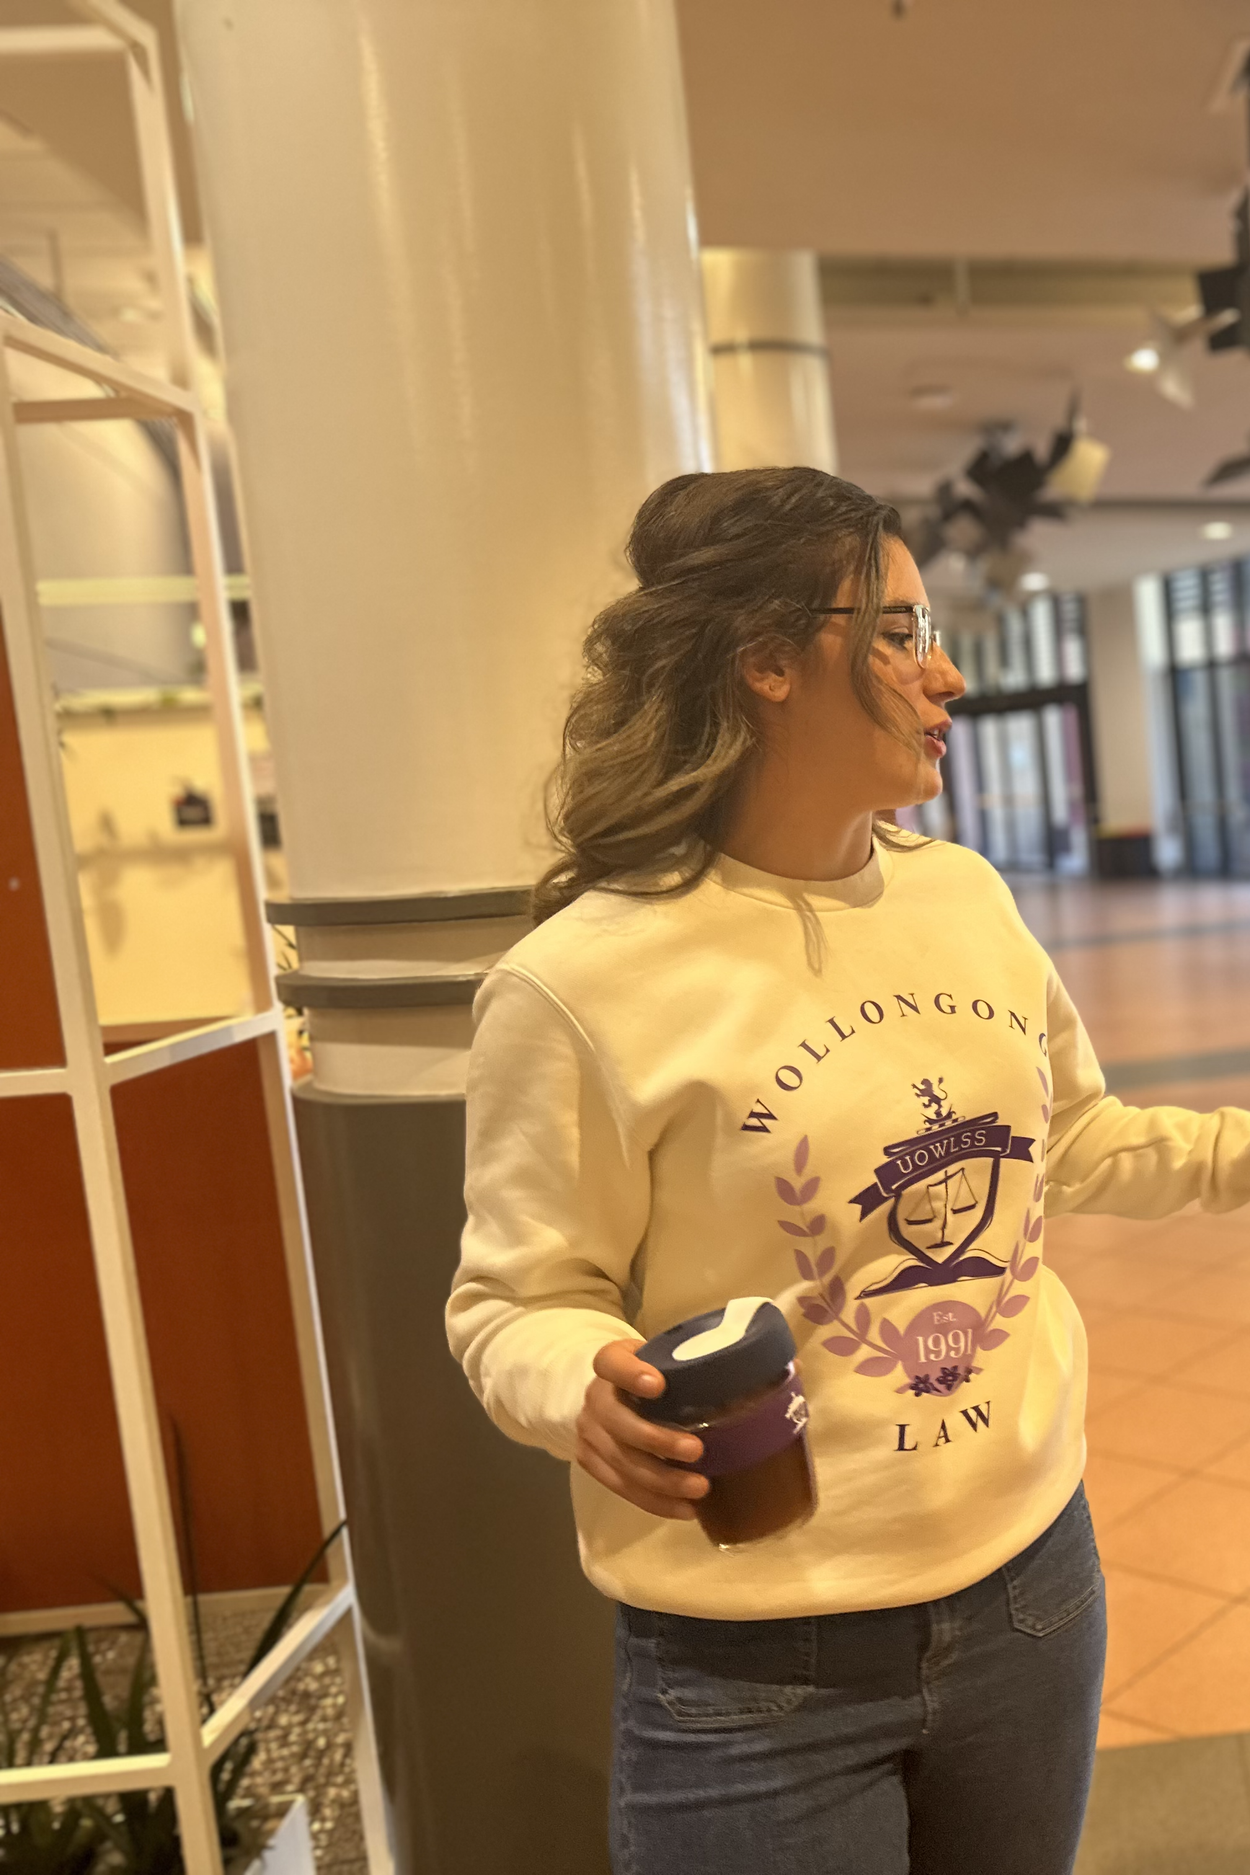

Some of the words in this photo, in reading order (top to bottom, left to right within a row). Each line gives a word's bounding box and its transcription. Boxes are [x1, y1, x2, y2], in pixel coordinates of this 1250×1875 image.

[741, 992, 1047, 1135] WOLLONGONG
[896, 1130, 986, 1174] UOWLSS
[916, 1328, 973, 1363] 1991
[893, 1400, 992, 1452] LAW
